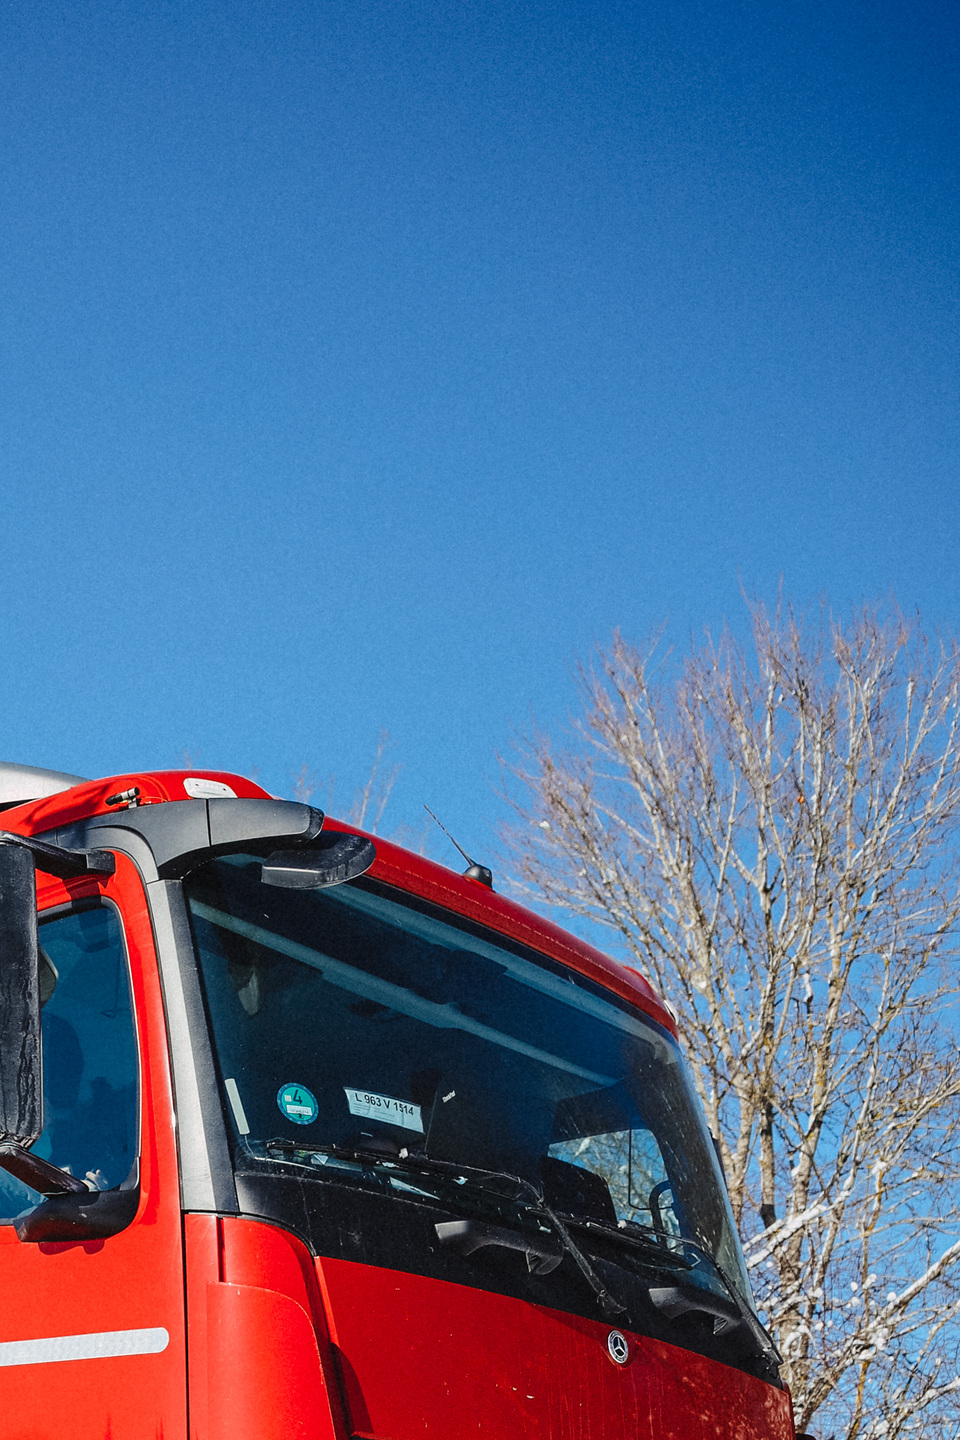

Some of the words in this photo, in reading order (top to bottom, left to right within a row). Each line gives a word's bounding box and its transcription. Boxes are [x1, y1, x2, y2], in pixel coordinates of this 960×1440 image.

[293, 1089, 303, 1105] 4
[355, 1092, 363, 1103] L
[364, 1094, 382, 1107] 963
[382, 1099, 391, 1109] V
[393, 1102, 414, 1116] 1514
